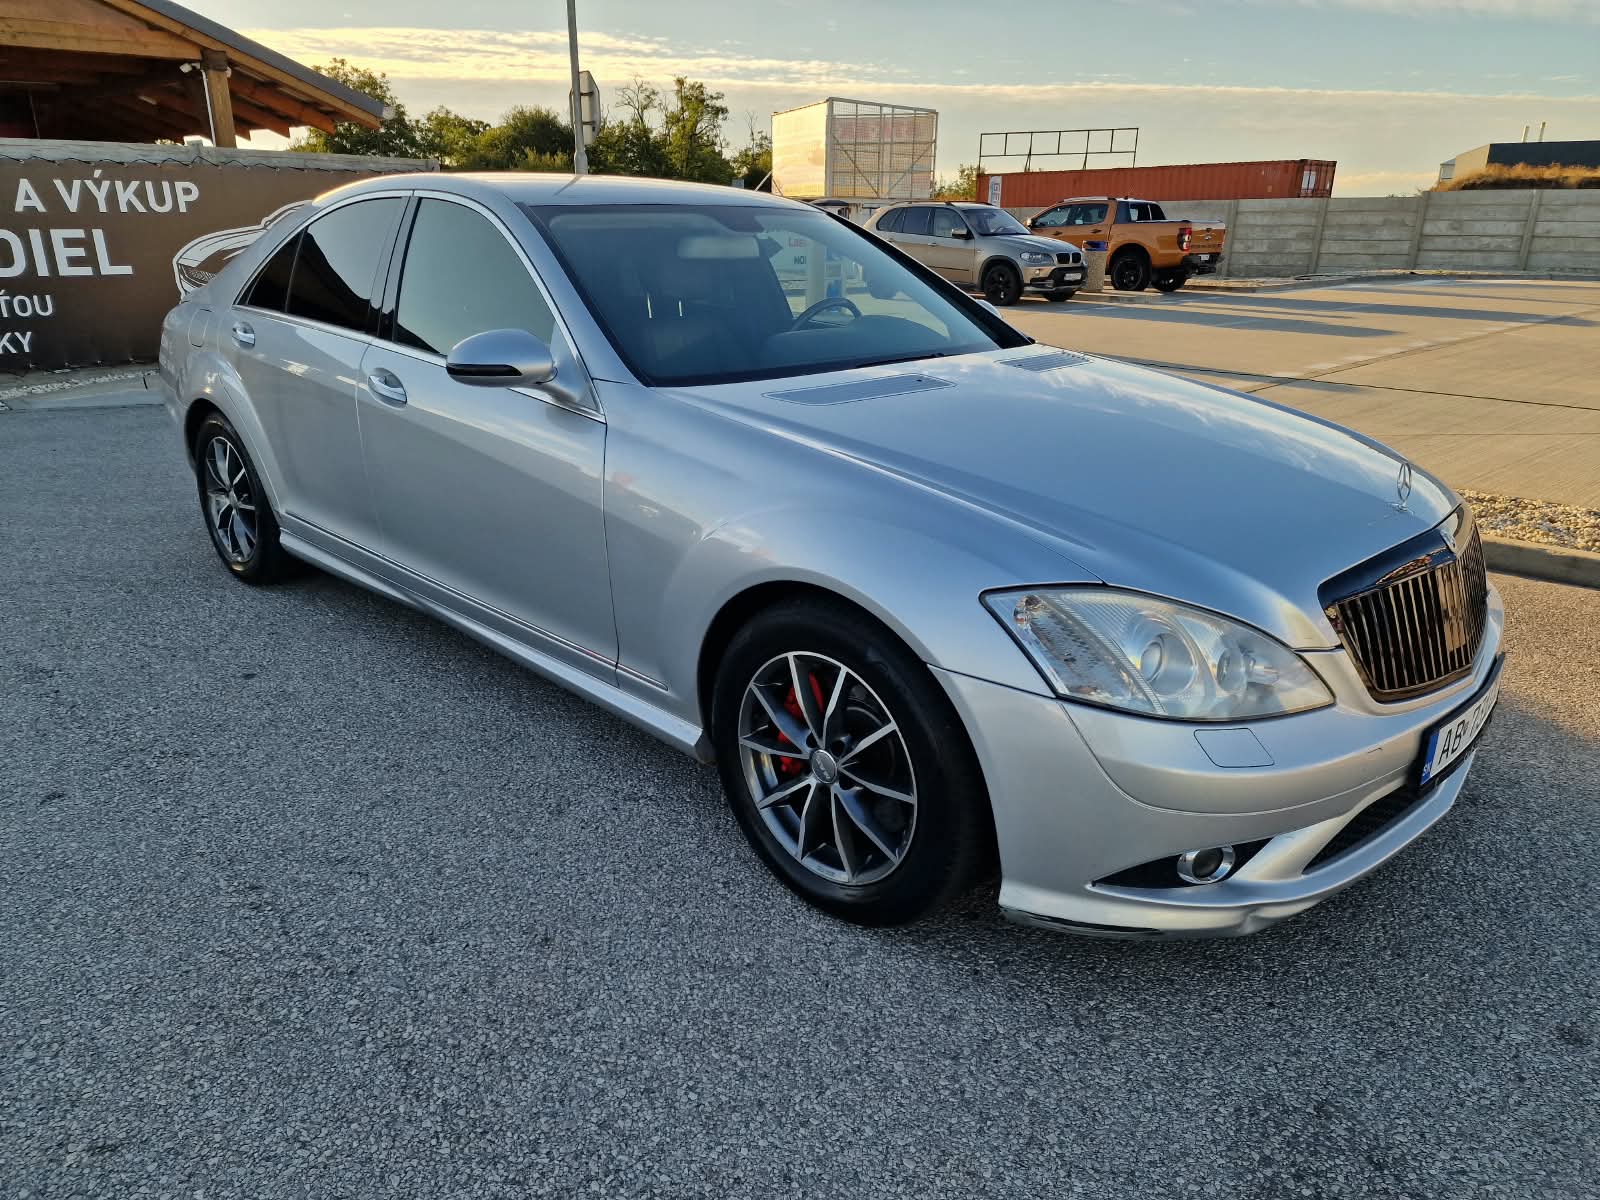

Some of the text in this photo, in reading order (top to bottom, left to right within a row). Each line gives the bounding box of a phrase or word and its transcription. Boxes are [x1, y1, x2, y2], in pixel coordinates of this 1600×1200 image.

[14, 169, 200, 213] A VÝKUP
[0, 228, 133, 278] DIEL
